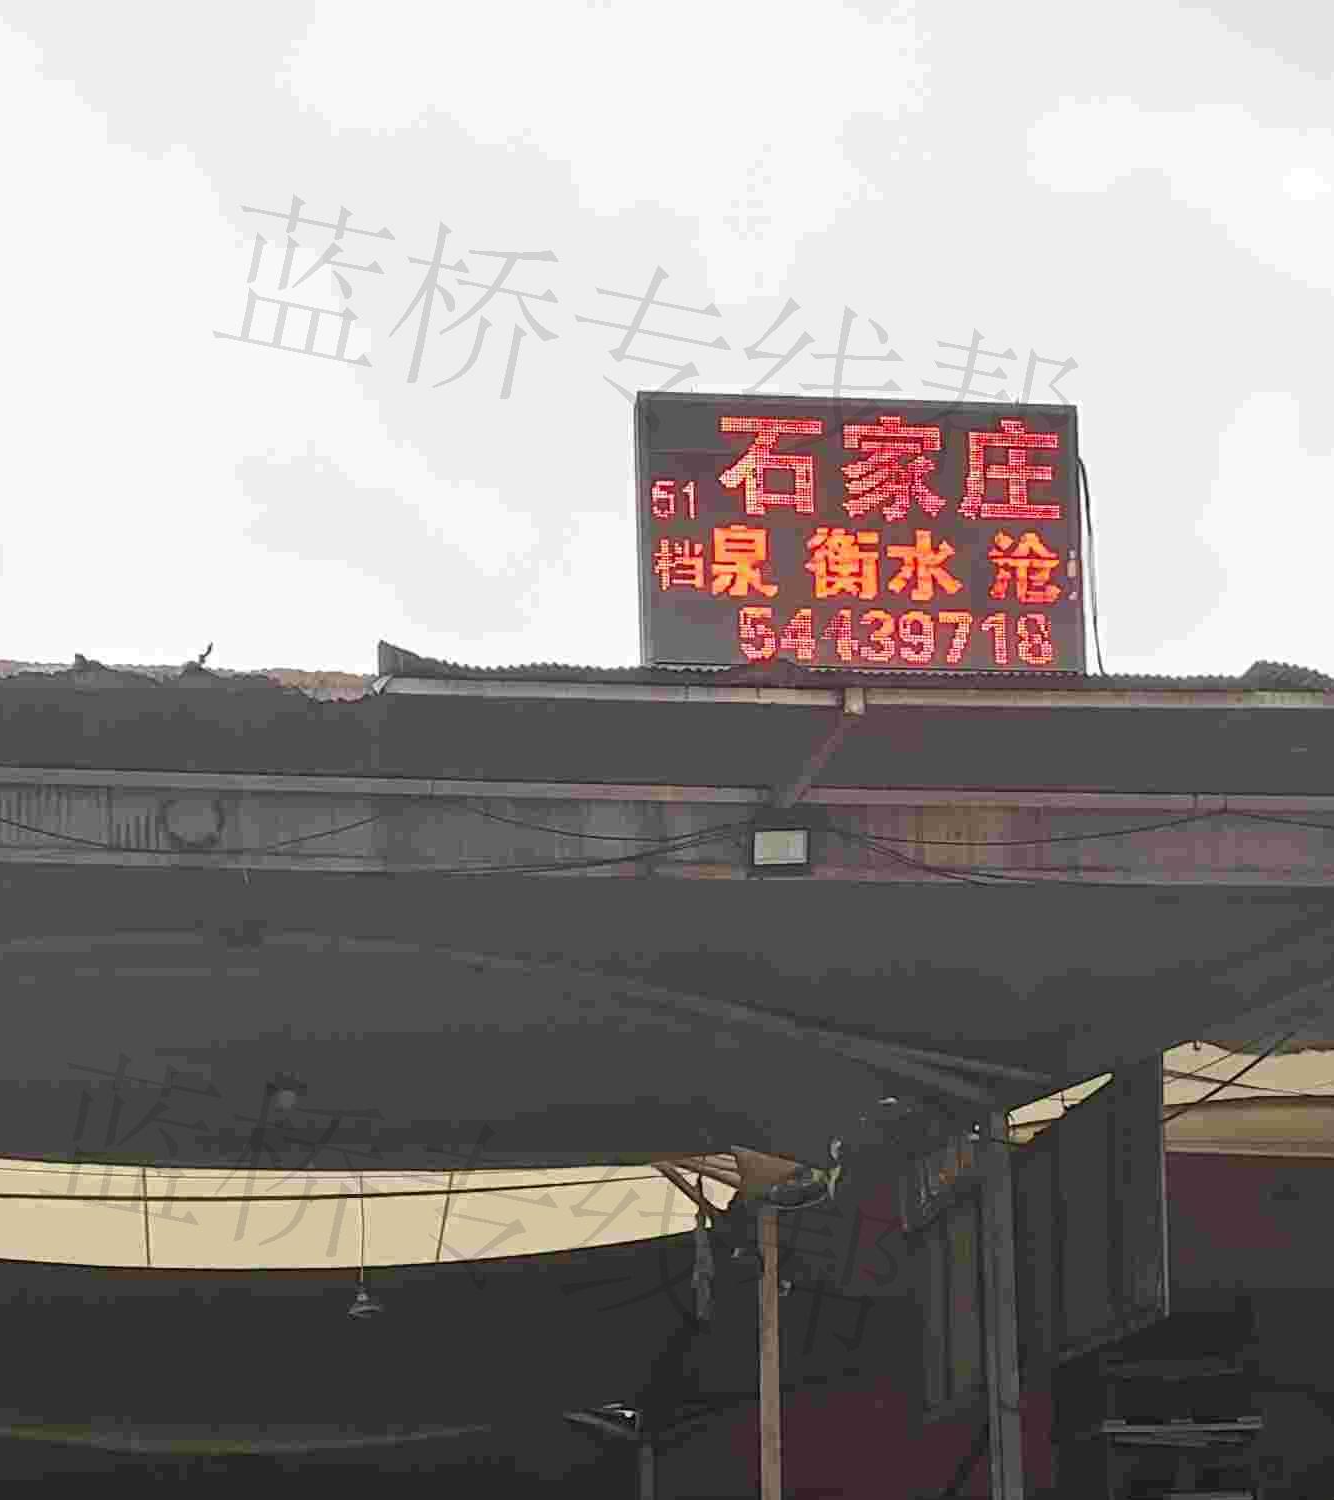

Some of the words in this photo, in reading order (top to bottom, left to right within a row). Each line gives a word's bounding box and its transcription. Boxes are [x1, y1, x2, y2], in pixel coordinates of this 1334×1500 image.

[650, 480, 698, 520] 51
[717, 416, 1063, 521] 石家庄
[653, 539, 705, 592] 档
[711, 525, 778, 598] 泉
[805, 527, 962, 600] 衡水
[987, 532, 1062, 604] 沧
